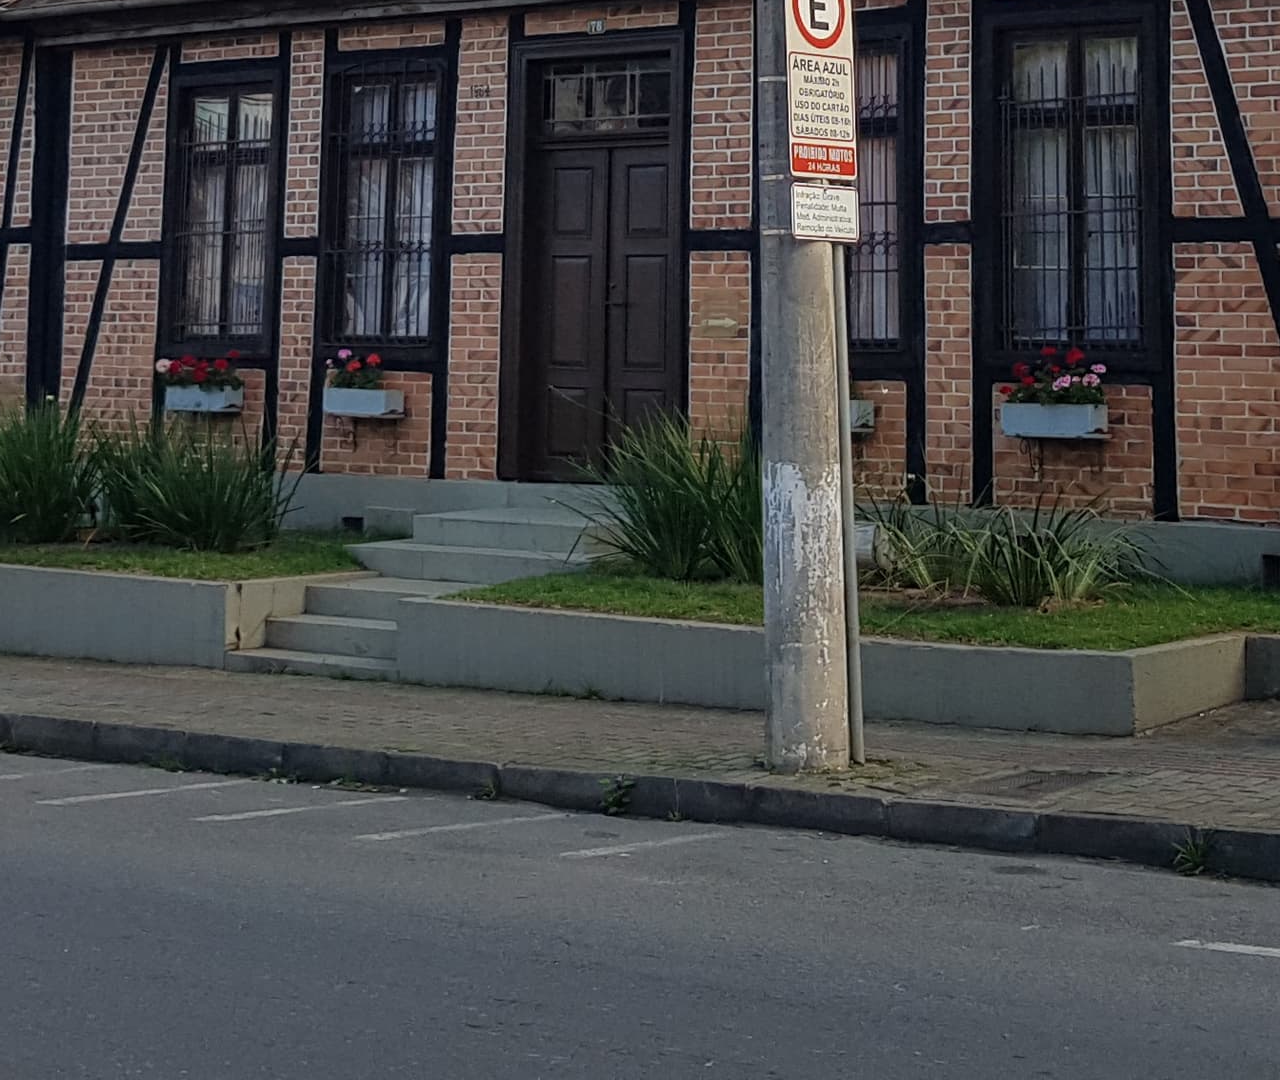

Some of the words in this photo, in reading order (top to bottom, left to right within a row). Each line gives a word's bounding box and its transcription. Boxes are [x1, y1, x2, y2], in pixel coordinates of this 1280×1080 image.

[792, 56, 821, 73] ÁREA
[823, 61, 848, 76] AZUL
[799, 87, 845, 100] OBRIGATÓRIO
[795, 100, 809, 110] USO
[811, 101, 821, 110] DO
[822, 102, 850, 113] CARTÃO
[793, 113, 809, 122] DIAS
[811, 111, 830, 124] ÚTEIS
[795, 123, 828, 137] SÁBADOS
